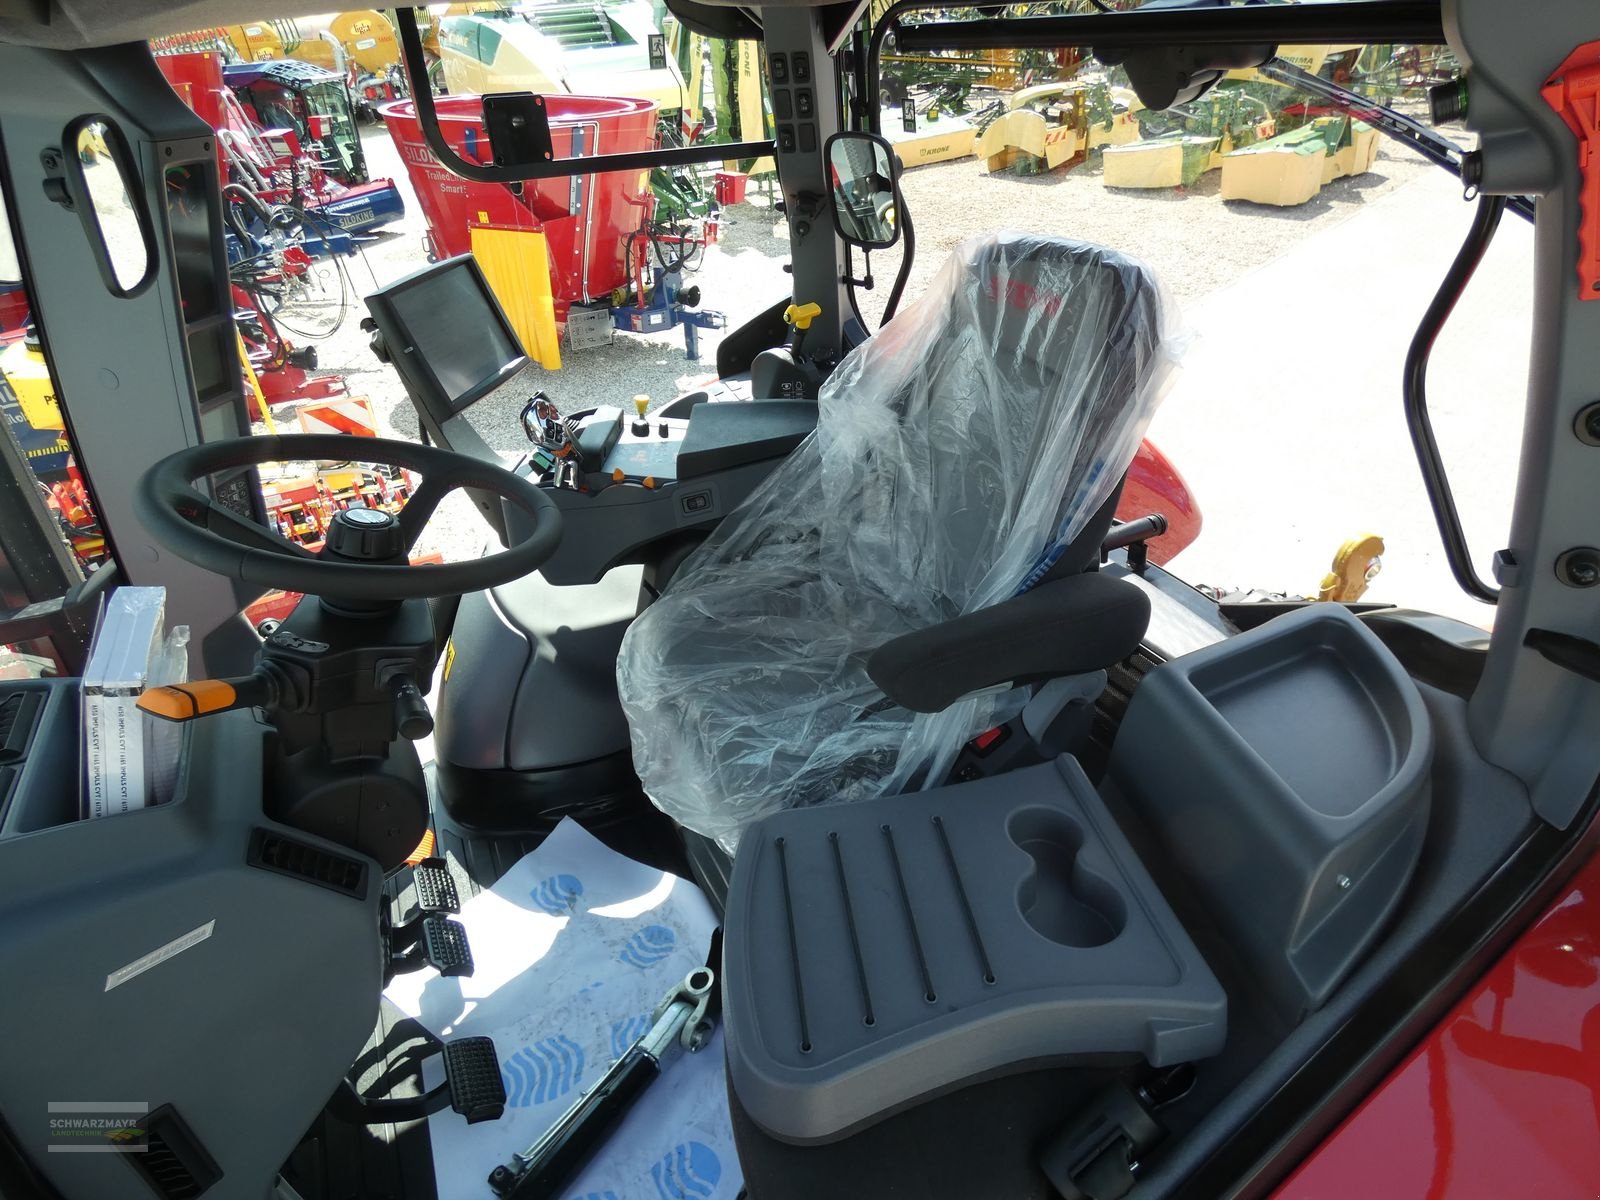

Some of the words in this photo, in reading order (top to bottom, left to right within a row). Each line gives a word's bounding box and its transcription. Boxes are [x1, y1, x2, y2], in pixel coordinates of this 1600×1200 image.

[926, 145, 950, 156] KRONE
[440, 183, 464, 194] Smart
[338, 210, 375, 227] SILOKING
